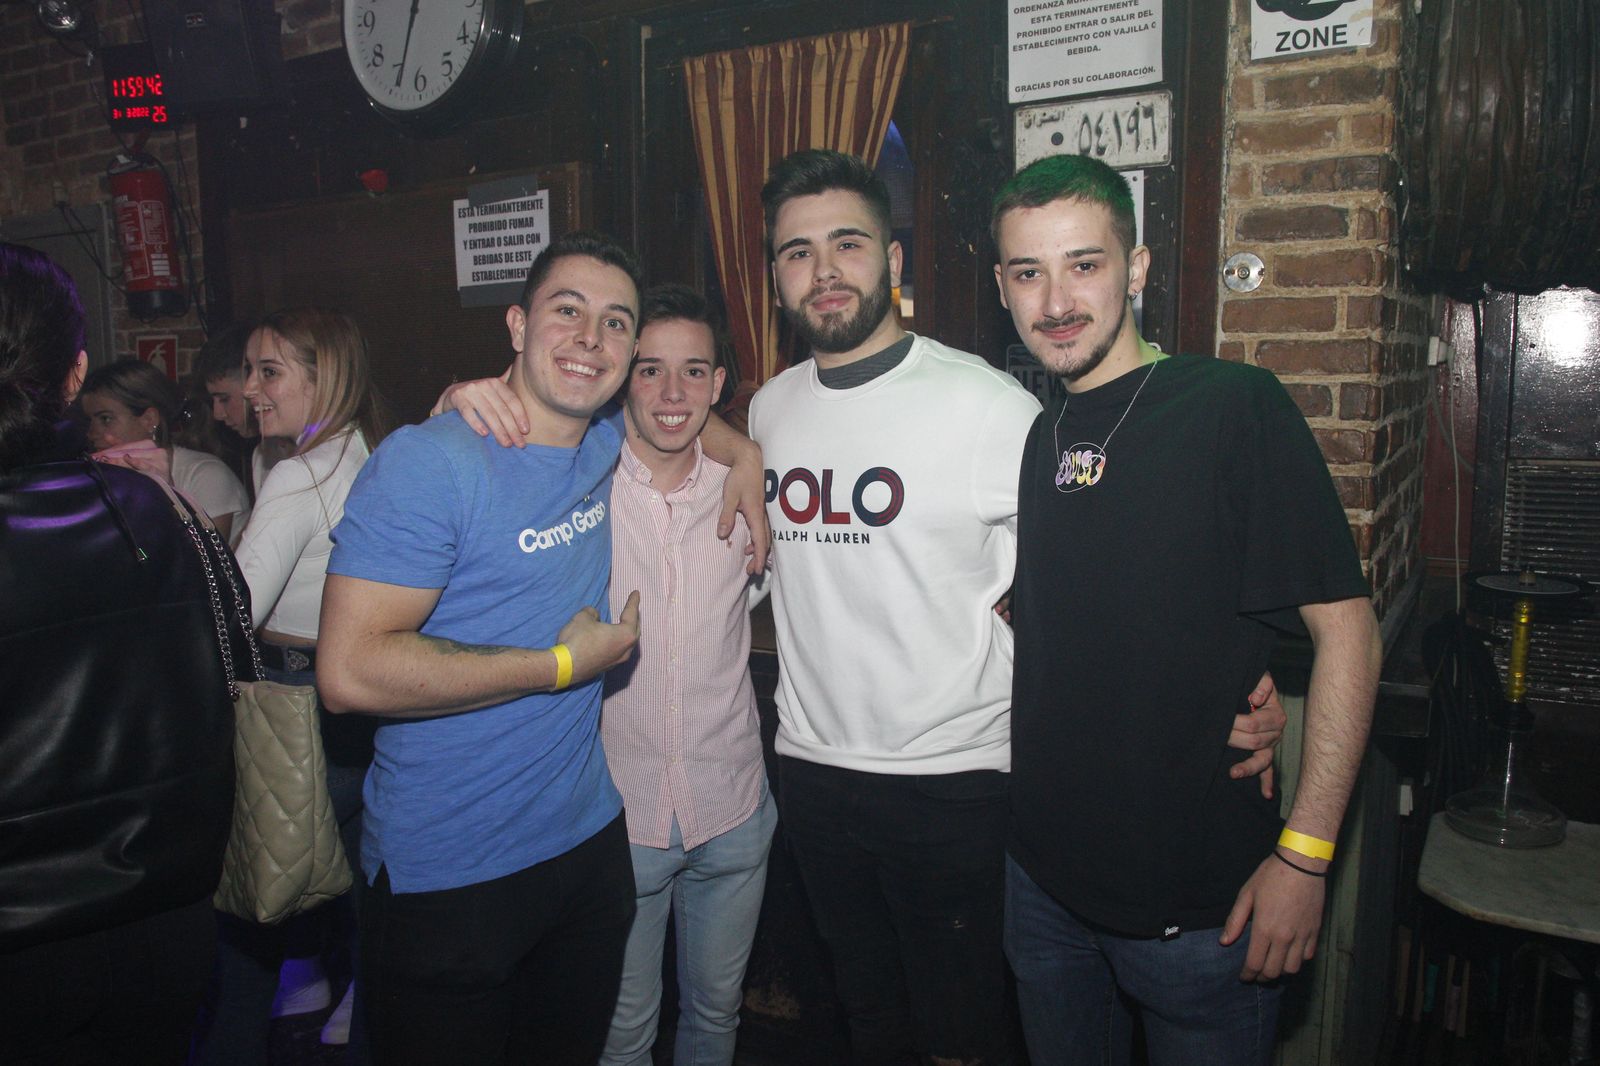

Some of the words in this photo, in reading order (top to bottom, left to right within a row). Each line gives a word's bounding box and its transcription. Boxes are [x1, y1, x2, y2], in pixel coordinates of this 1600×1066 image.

[1013, 0, 1065, 14] ORDENANZA
[1030, 15, 1052, 24] ESTA
[1054, 0, 1139, 20] TERMINANTEMENTE
[1016, 26, 1062, 39] PROHIBIDO
[1064, 19, 1099, 31] ENTRAR
[1110, 13, 1135, 23] SALIR
[1138, 9, 1153, 18] DEL
[1012, 34, 1090, 52] ESTABLECIMIENTO
[1092, 30, 1111, 39] CON
[1113, 24, 1149, 35] VAJILLA
[1275, 24, 1347, 52] ZONE
[1067, 45, 1101, 56] BEBIDA.
[1015, 81, 1051, 93] GRACIAS
[1053, 78, 1070, 87] POR
[1072, 76, 1084, 84] SU
[1086, 66, 1156, 82] COLABORACIÓN.
[458, 206, 475, 218] ESTA
[475, 199, 544, 216] TERMINANTEMENTE
[468, 219, 507, 234] PROHIBIDO
[509, 217, 534, 230] FUMAR
[463, 240, 468, 250] Y
[469, 237, 495, 250] ENTRAR
[497, 236, 502, 247] O
[503, 234, 524, 247] SALIR
[526, 233, 541, 244] CON
[473, 253, 503, 266] BEBIDAS
[504, 252, 514, 263] DE
[515, 251, 532, 262] ESTE
[472, 268, 530, 282] ESTABLECIMIENT
[764, 466, 905, 527] POLO
[518, 522, 574, 553] Camp
[773, 529, 808, 542] RALPH
[816, 531, 870, 544] LAUREN
